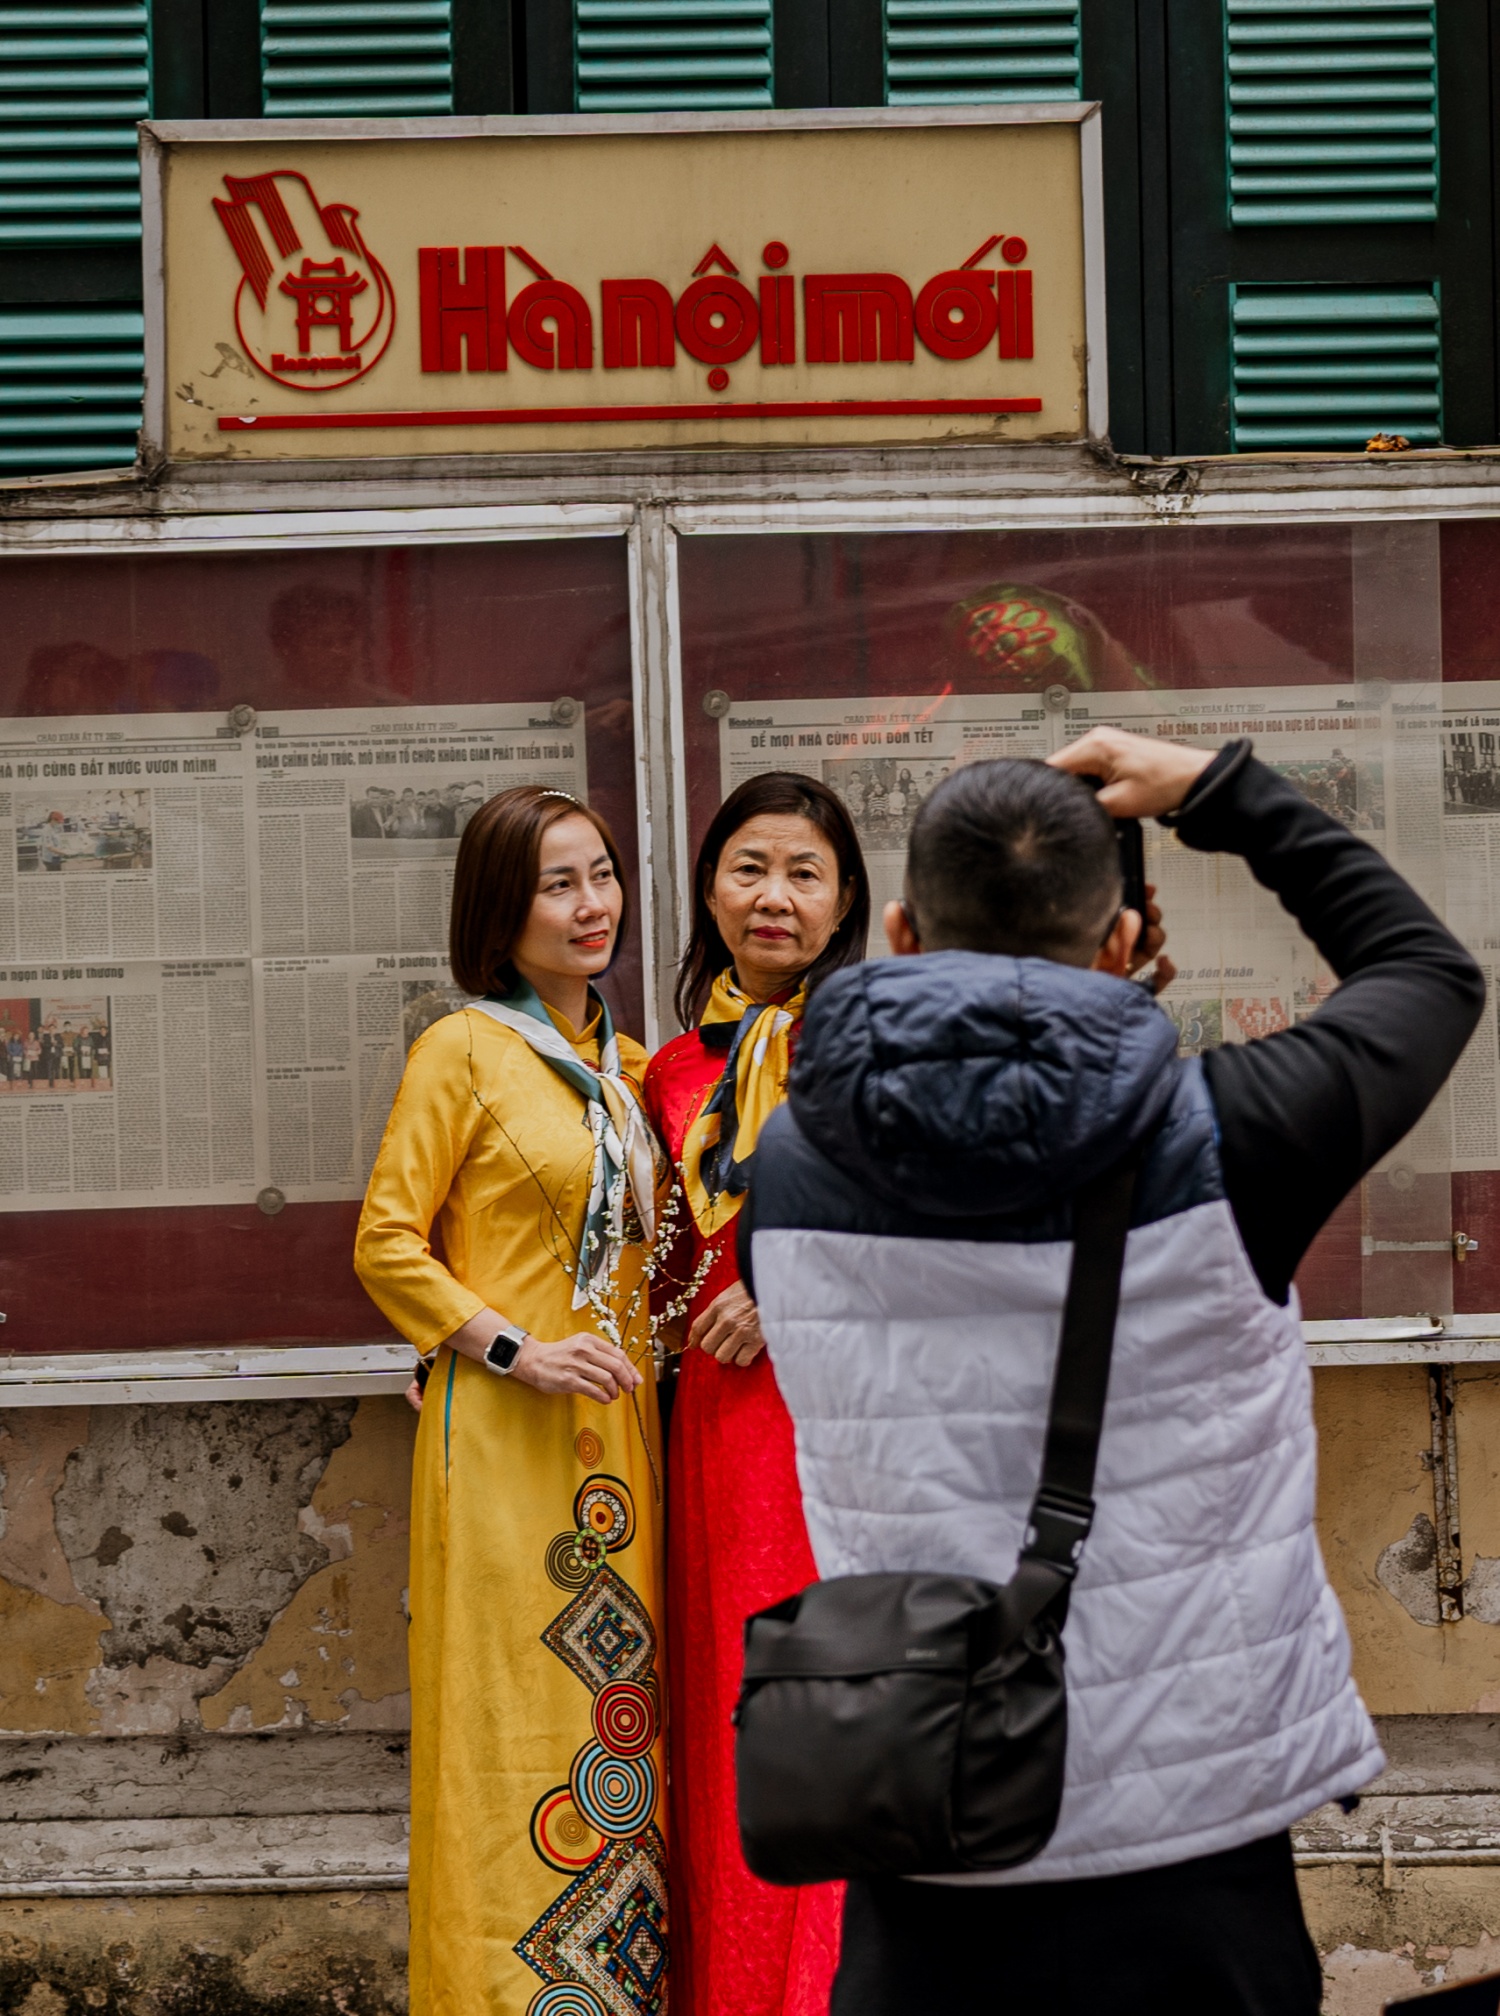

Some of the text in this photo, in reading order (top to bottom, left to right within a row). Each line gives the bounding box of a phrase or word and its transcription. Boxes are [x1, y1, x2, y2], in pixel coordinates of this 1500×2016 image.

[1039, 709, 1046, 720] 5
[1064, 708, 1071, 720] 6
[1176, 720, 1198, 736] SÀNG
[1200, 722, 1218, 734] CHO
[751, 726, 934, 750] ĐỂ MỌI NHÀ CÙNG VUI ĐÓN TẾT
[256, 752, 280, 768] HOÀN
[438, 746, 468, 763] KHÔNG
[470, 748, 490, 762] GIAN
[492, 745, 514, 760] PHÁT
[18, 762, 38, 780] NỘI
[42, 760, 76, 777] CÙNG
[80, 757, 104, 776] ĐẤT
[108, 758, 142, 775] NƯỚC
[146, 759, 178, 774] VƯƠN
[183, 756, 217, 773] MÌNH
[376, 955, 396, 968] Phố
[399, 954, 438, 968] phường
[10, 970, 38, 982] ngọn
[42, 967, 59, 980] lửa
[62, 967, 82, 980] yêu
[86, 967, 124, 979] thương
[1197, 968, 1220, 979] đón
[1223, 966, 1254, 978] Xuân
